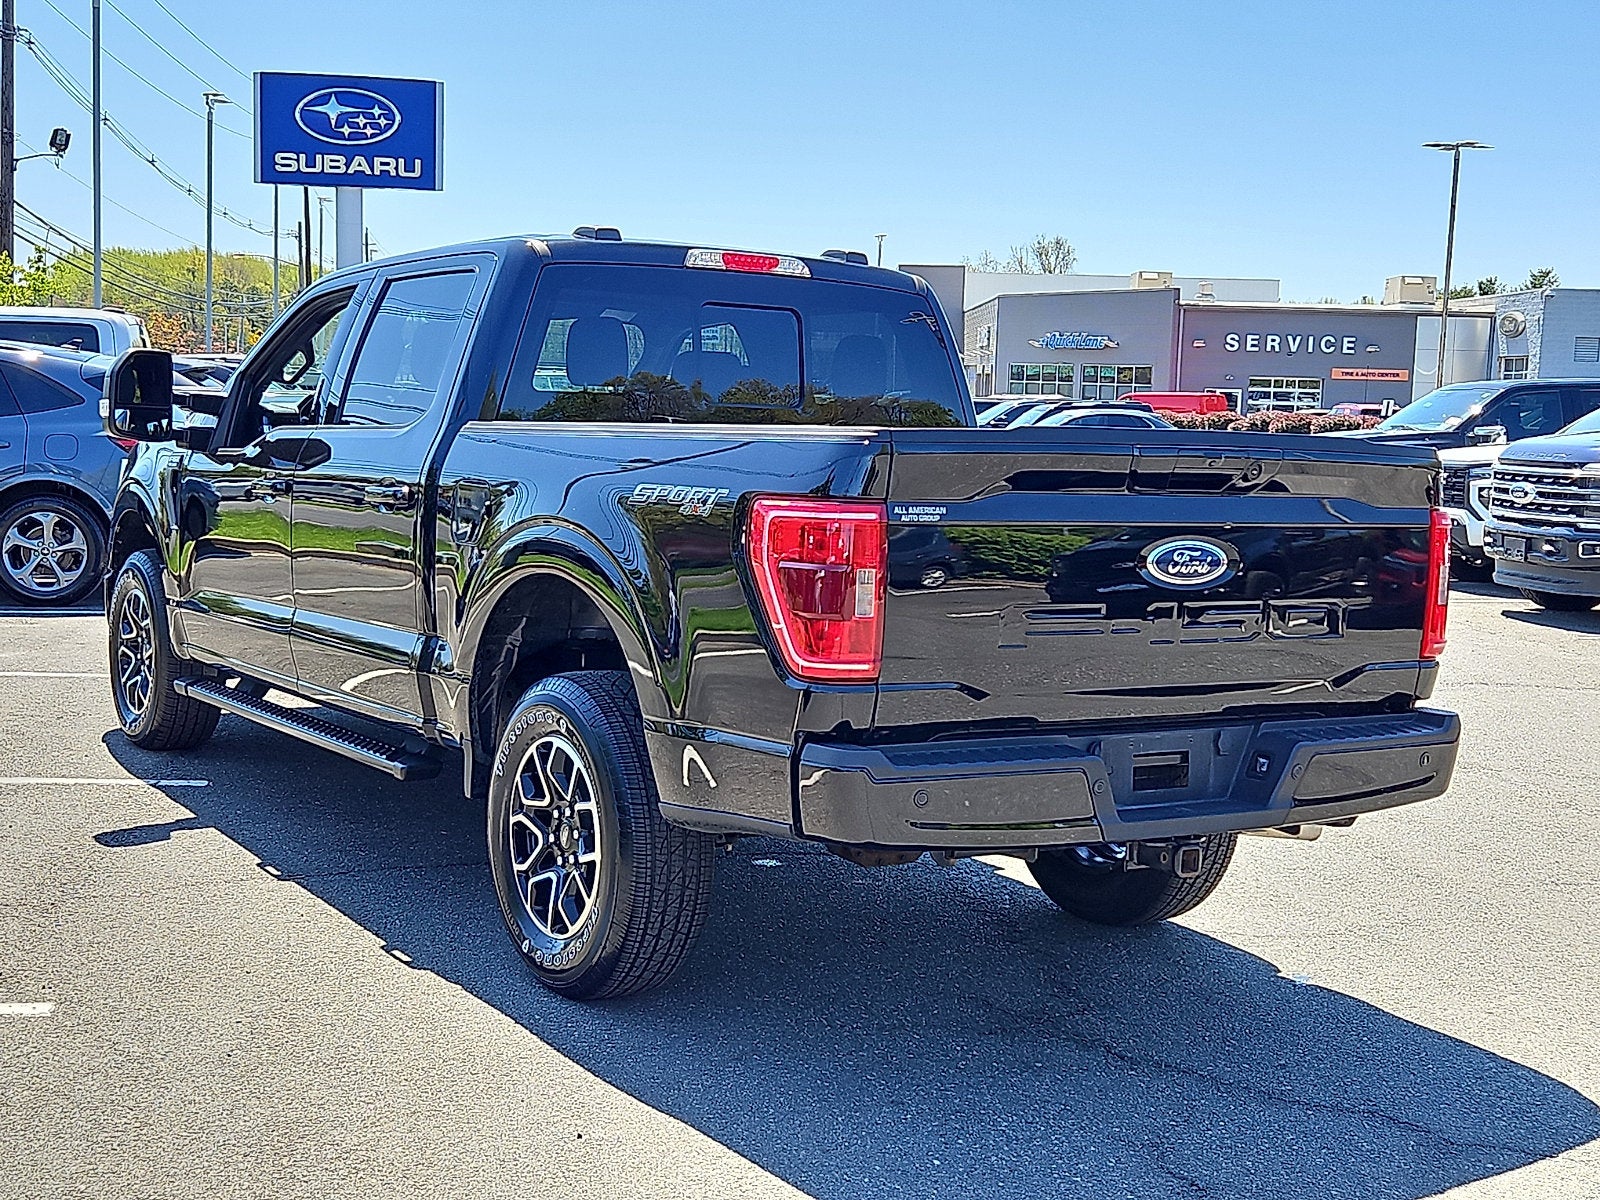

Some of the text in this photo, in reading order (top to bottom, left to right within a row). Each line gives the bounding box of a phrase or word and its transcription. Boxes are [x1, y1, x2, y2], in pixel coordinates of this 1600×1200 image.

[274, 152, 422, 178] SUBARU
[1224, 333, 1357, 354] SERVICE
[627, 483, 730, 506] SPORT
[893, 506, 947, 514] ALL AMERICAN
[1167, 550, 1213, 574] Ford
[495, 711, 554, 777] Firestone
